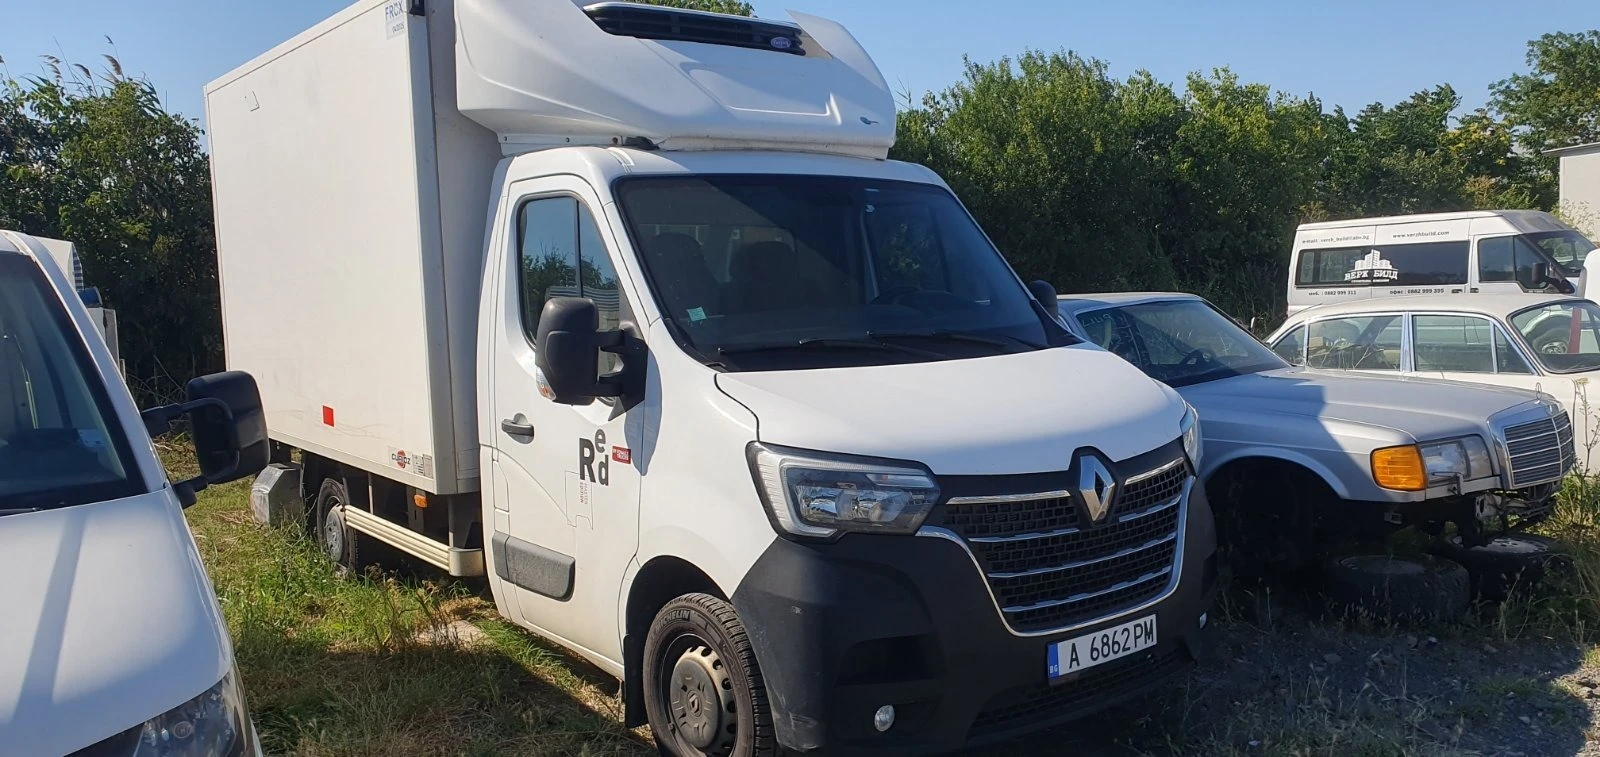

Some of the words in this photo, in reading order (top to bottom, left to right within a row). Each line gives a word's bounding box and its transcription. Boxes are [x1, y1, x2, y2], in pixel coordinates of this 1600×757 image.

[1373, 269, 1398, 280] БИЛД
[1069, 642, 1080, 669] A
[1049, 664, 1059, 673] BG
